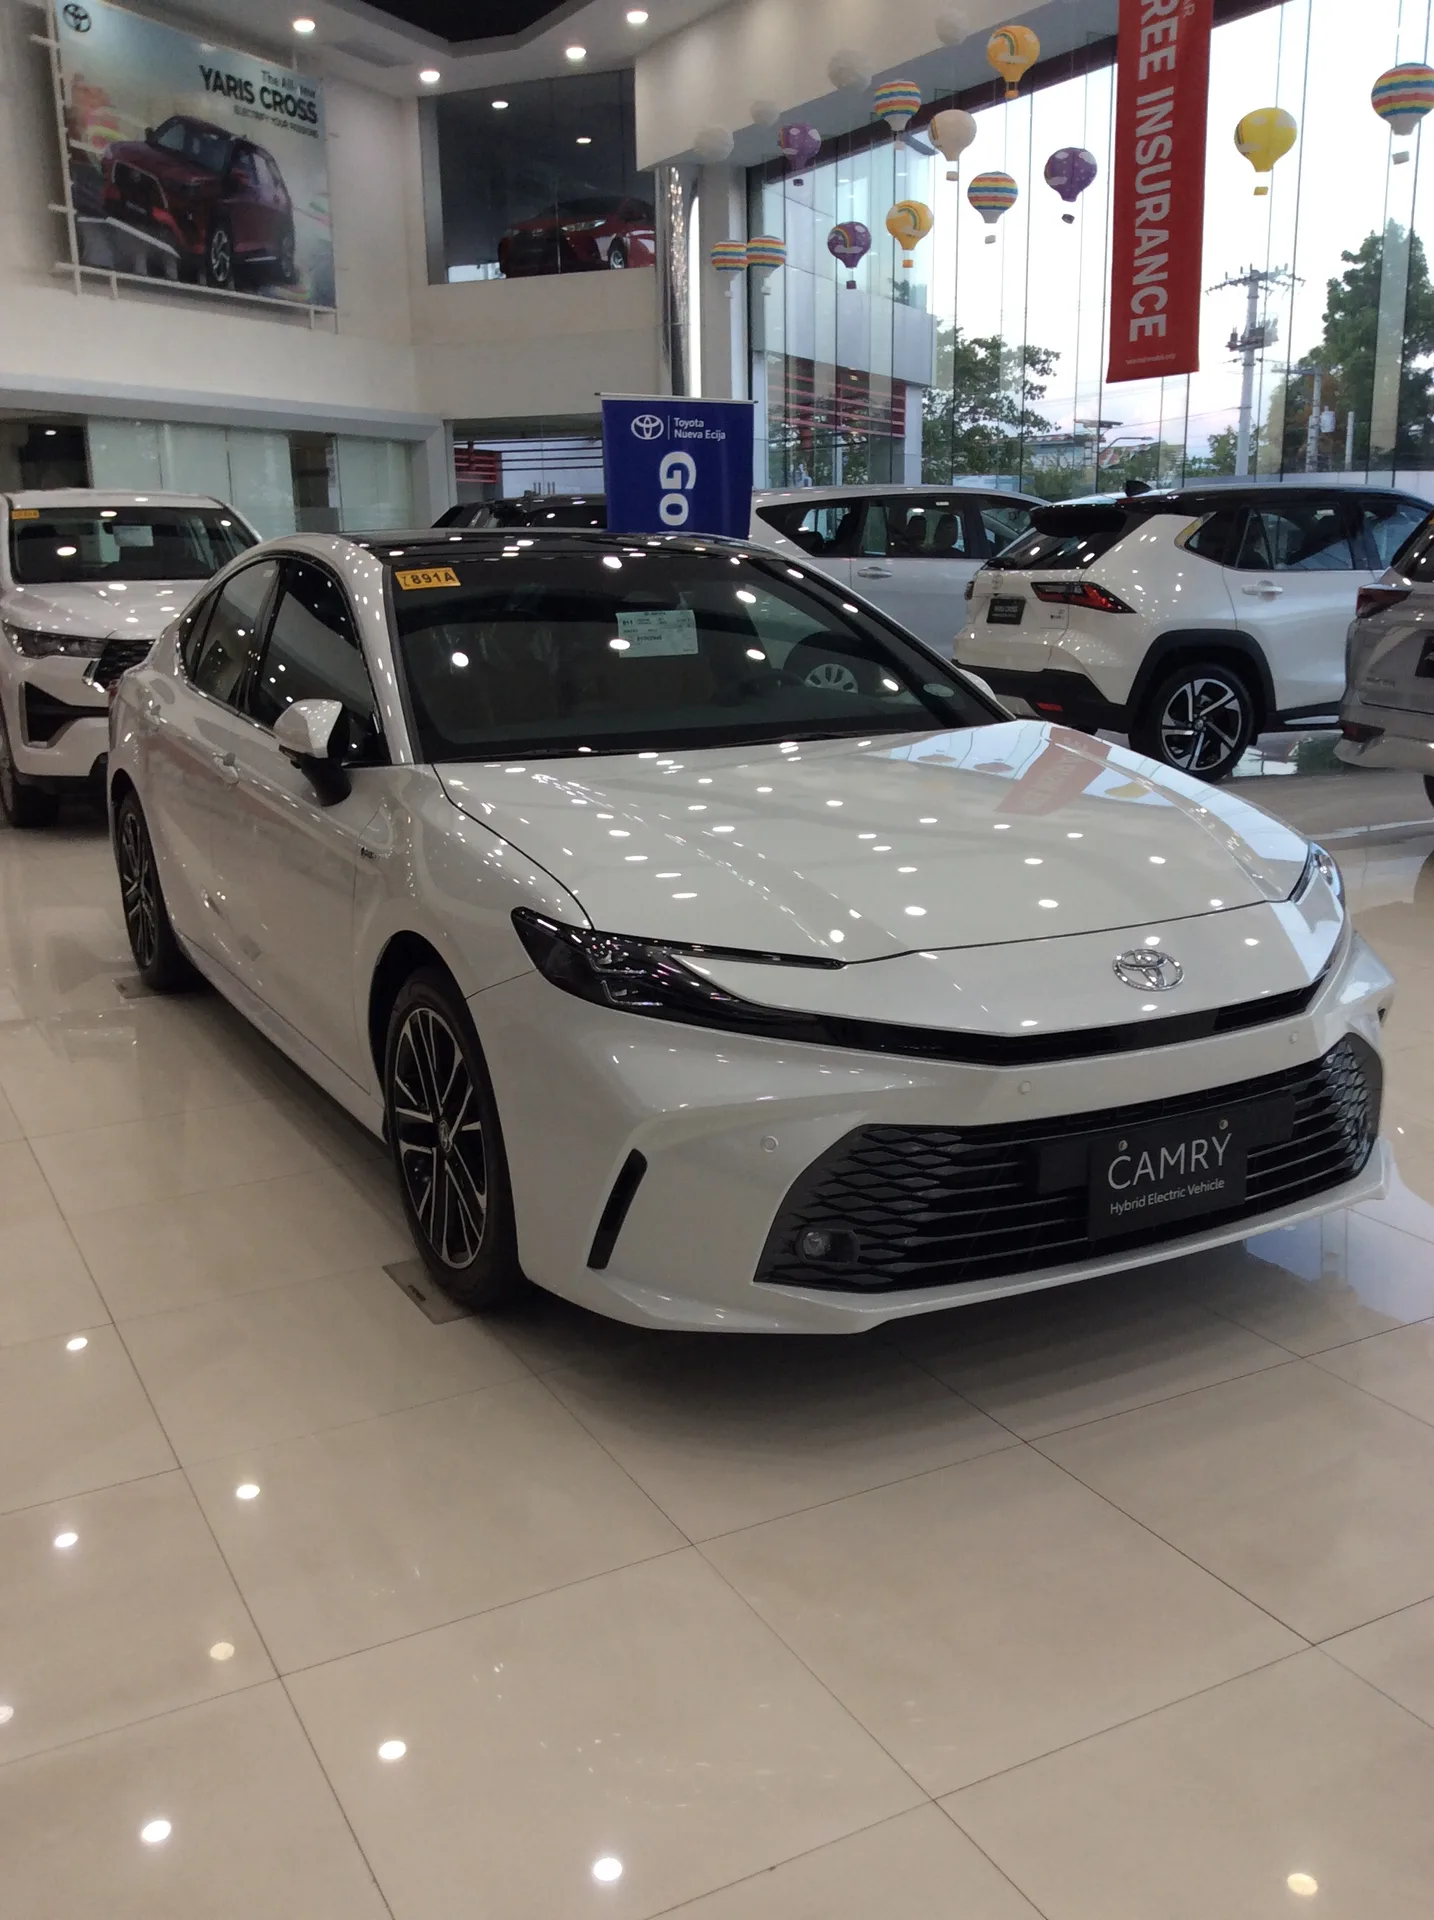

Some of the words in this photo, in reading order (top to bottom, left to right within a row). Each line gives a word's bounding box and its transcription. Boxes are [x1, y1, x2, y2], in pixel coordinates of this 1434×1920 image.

[199, 64, 255, 104] YARIS
[260, 86, 317, 124] CROSS
[1129, 86, 1175, 342] INSURANCE
[674, 417, 704, 429] Toyota
[674, 429, 703, 439] Nueva
[705, 430, 726, 441] Ecija
[659, 451, 697, 526] GO
[1108, 1133, 1232, 1190] CAMRY
[1110, 1195, 1146, 1215] Hybrid
[1148, 1187, 1186, 1206] Electric
[1188, 1178, 1225, 1196] Vehicle
